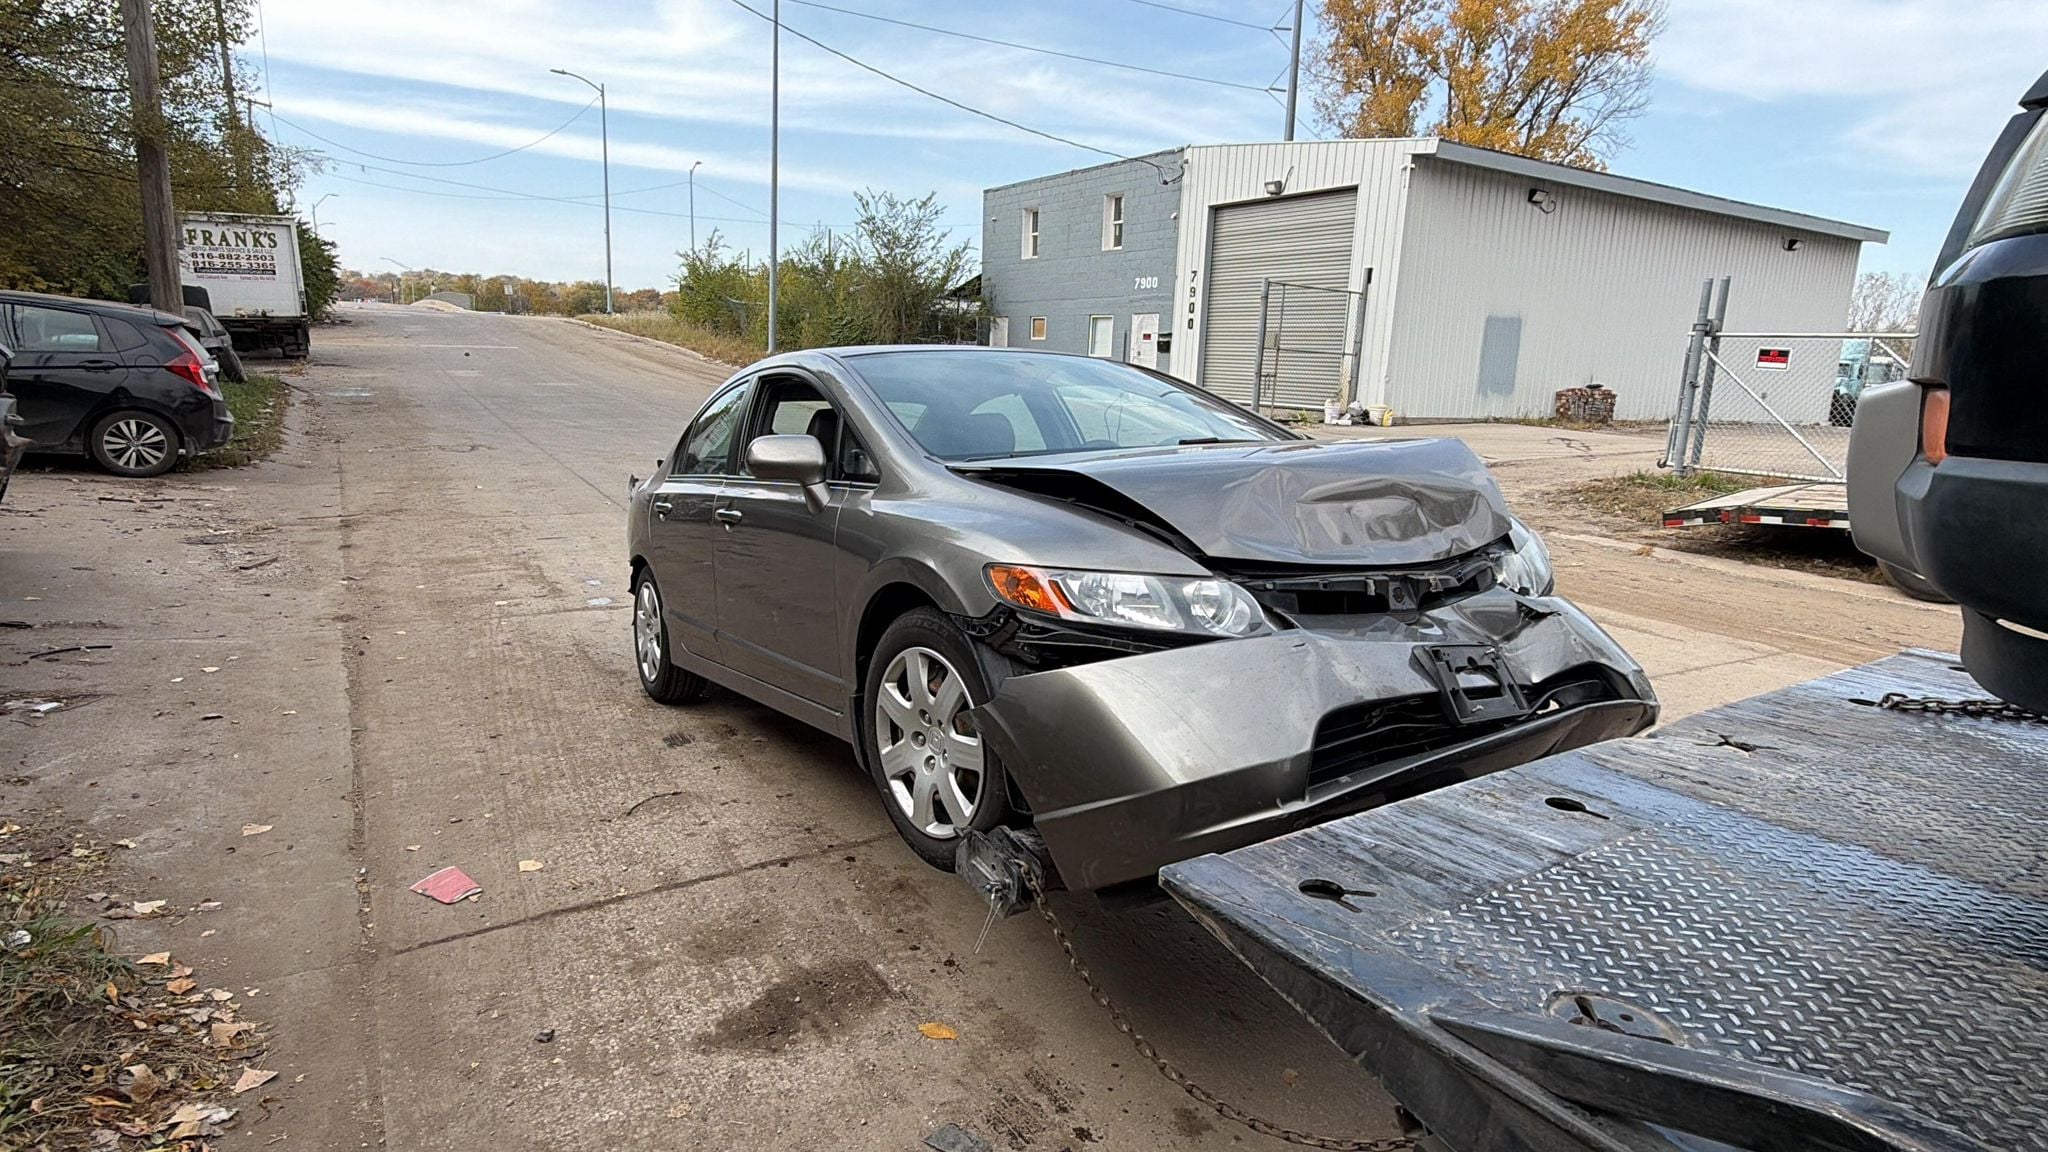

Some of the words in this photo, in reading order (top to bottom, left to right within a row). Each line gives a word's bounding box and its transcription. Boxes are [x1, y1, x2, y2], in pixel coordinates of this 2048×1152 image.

[186, 229, 278, 248] FRANK'S
[191, 252, 274, 261] 816-882-2503
[1134, 277, 1158, 289] 7900
